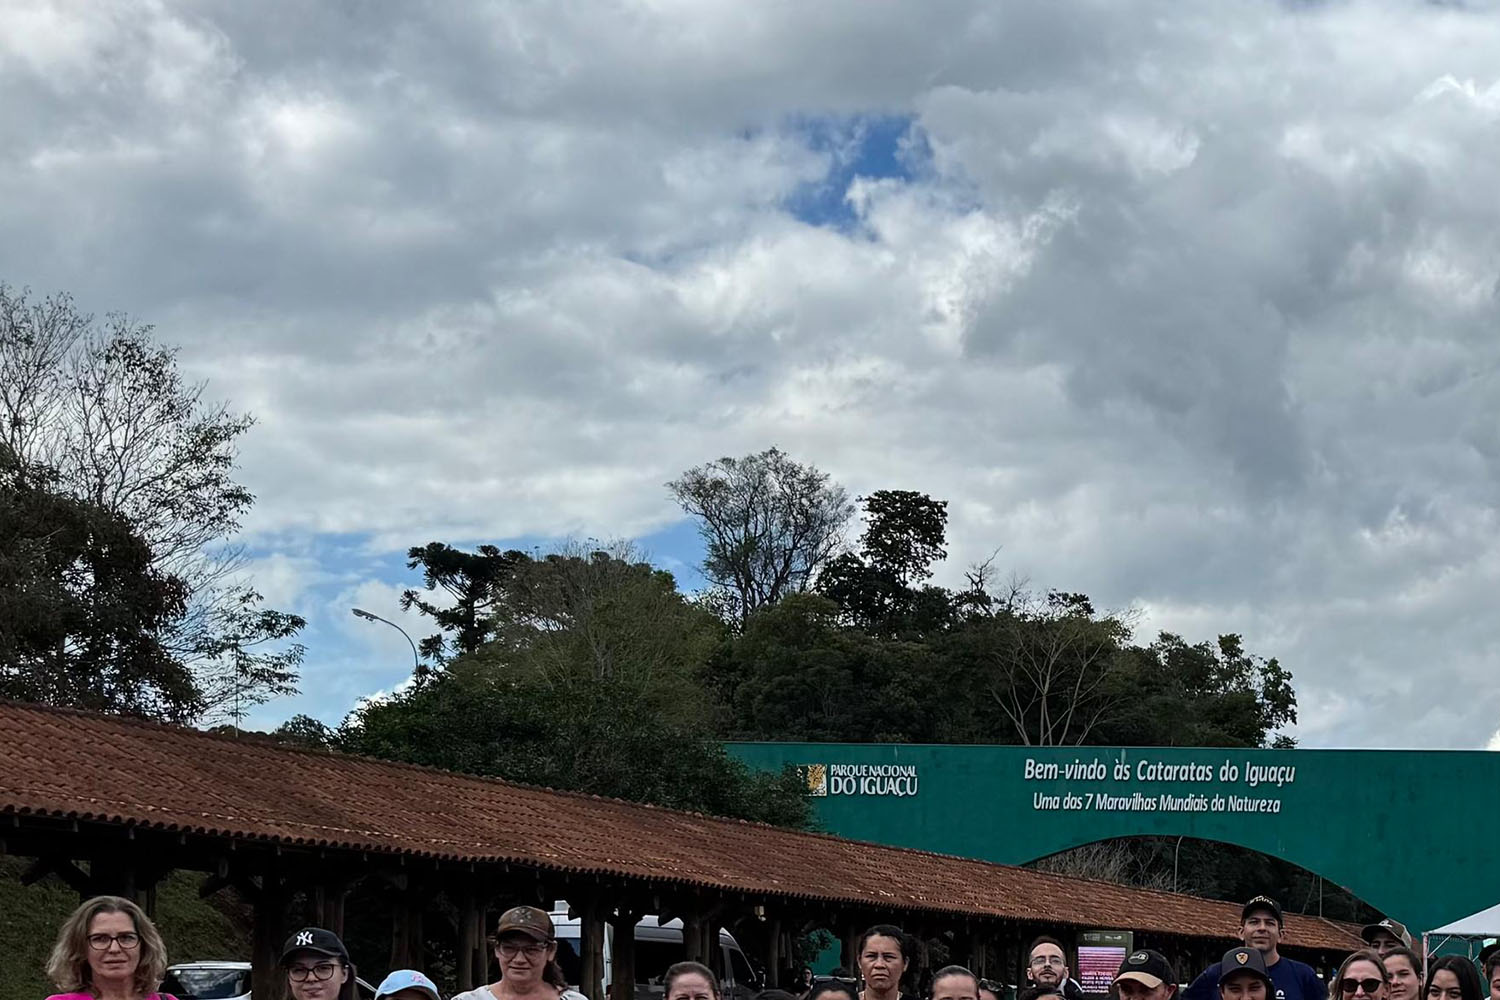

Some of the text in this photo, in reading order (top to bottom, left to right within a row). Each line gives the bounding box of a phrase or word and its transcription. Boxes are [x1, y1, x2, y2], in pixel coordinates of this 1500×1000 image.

[831, 764, 917, 778] PARQUE NACIONAL
[1024, 758, 1295, 787] Bem-vindo às Cataratas do Iguaçu
[831, 776, 918, 797] DO IGUAÇU
[1033, 792, 1281, 813] Uma das 7 Maravilhas Mundiais da Natureza
[296, 931, 313, 946] NY
